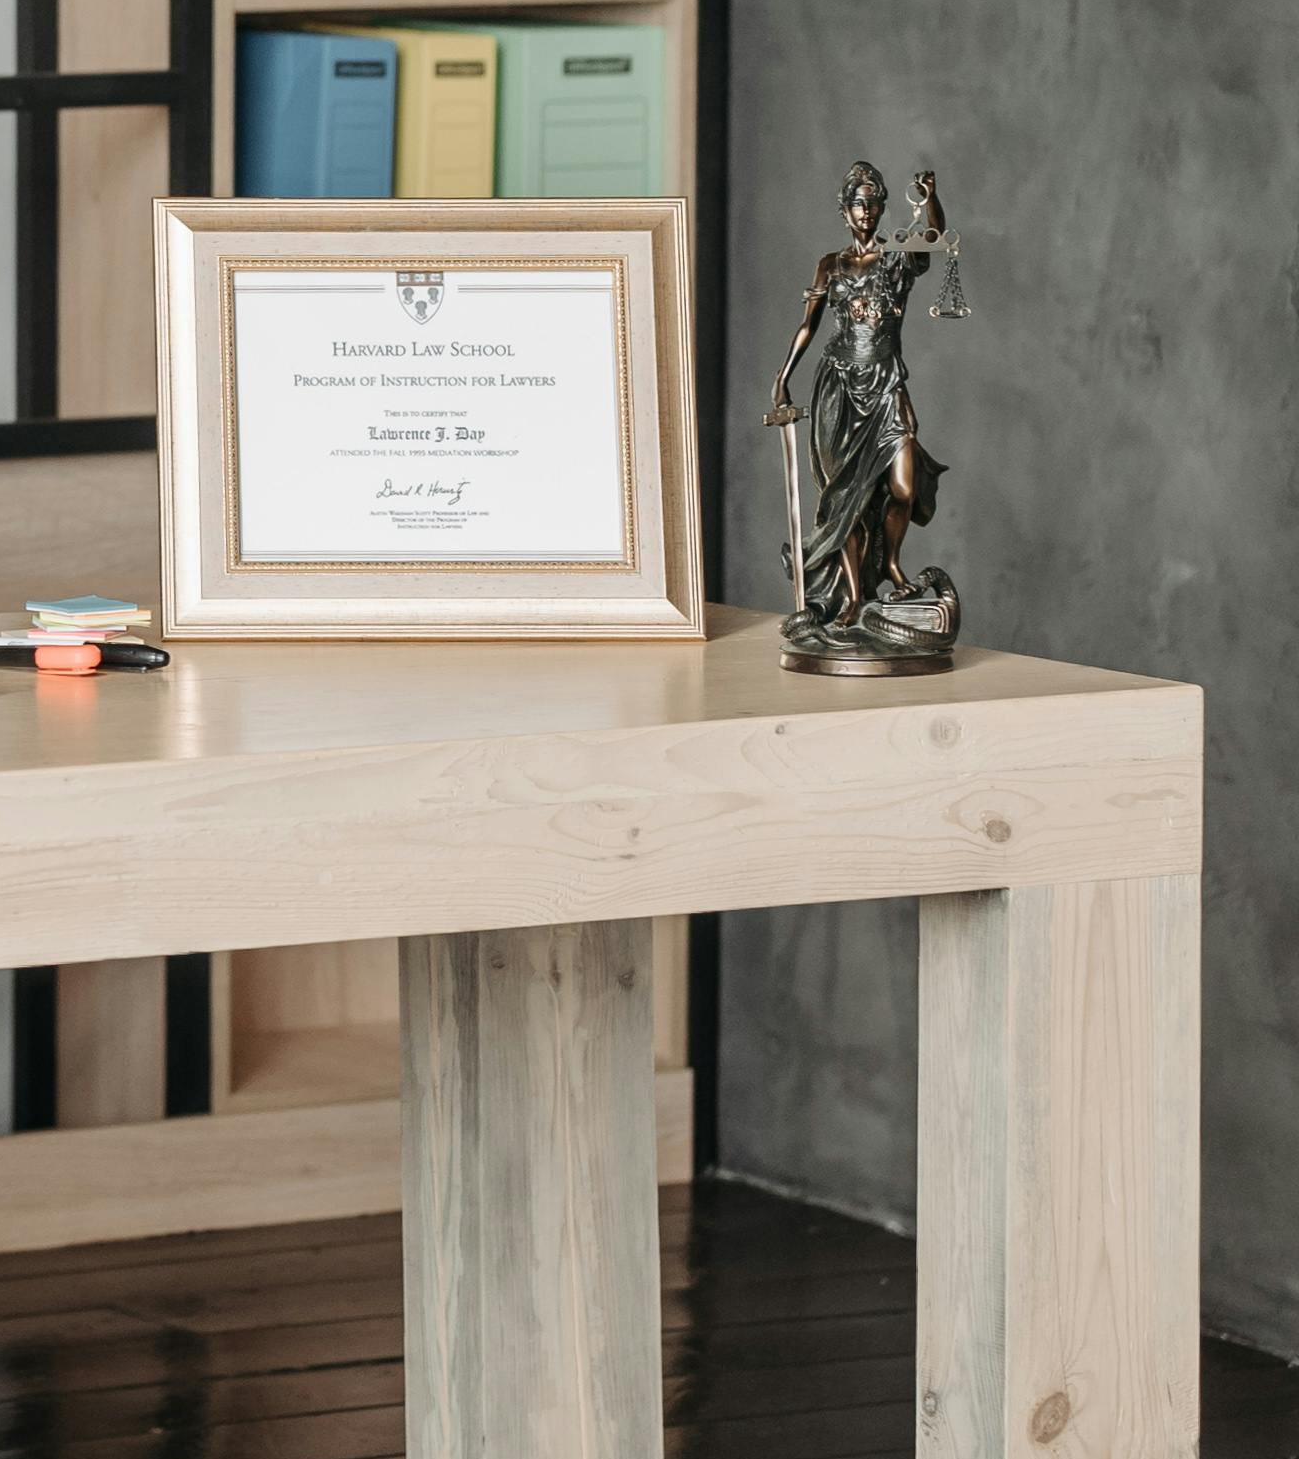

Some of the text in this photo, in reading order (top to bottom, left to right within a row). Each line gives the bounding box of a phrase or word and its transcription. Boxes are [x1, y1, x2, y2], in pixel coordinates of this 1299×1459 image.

[332, 340, 515, 358] HARVARD LAW SCHOOL
[293, 373, 556, 387] PROGRAM OF INSTRUCTION FOR LAWYERS
[367, 425, 431, 441] Lawrence
[455, 426, 486, 443] Day
[373, 449, 387, 457] THE
[427, 449, 472, 457] MEDIATION
[472, 449, 520, 457] WORKSHOP
